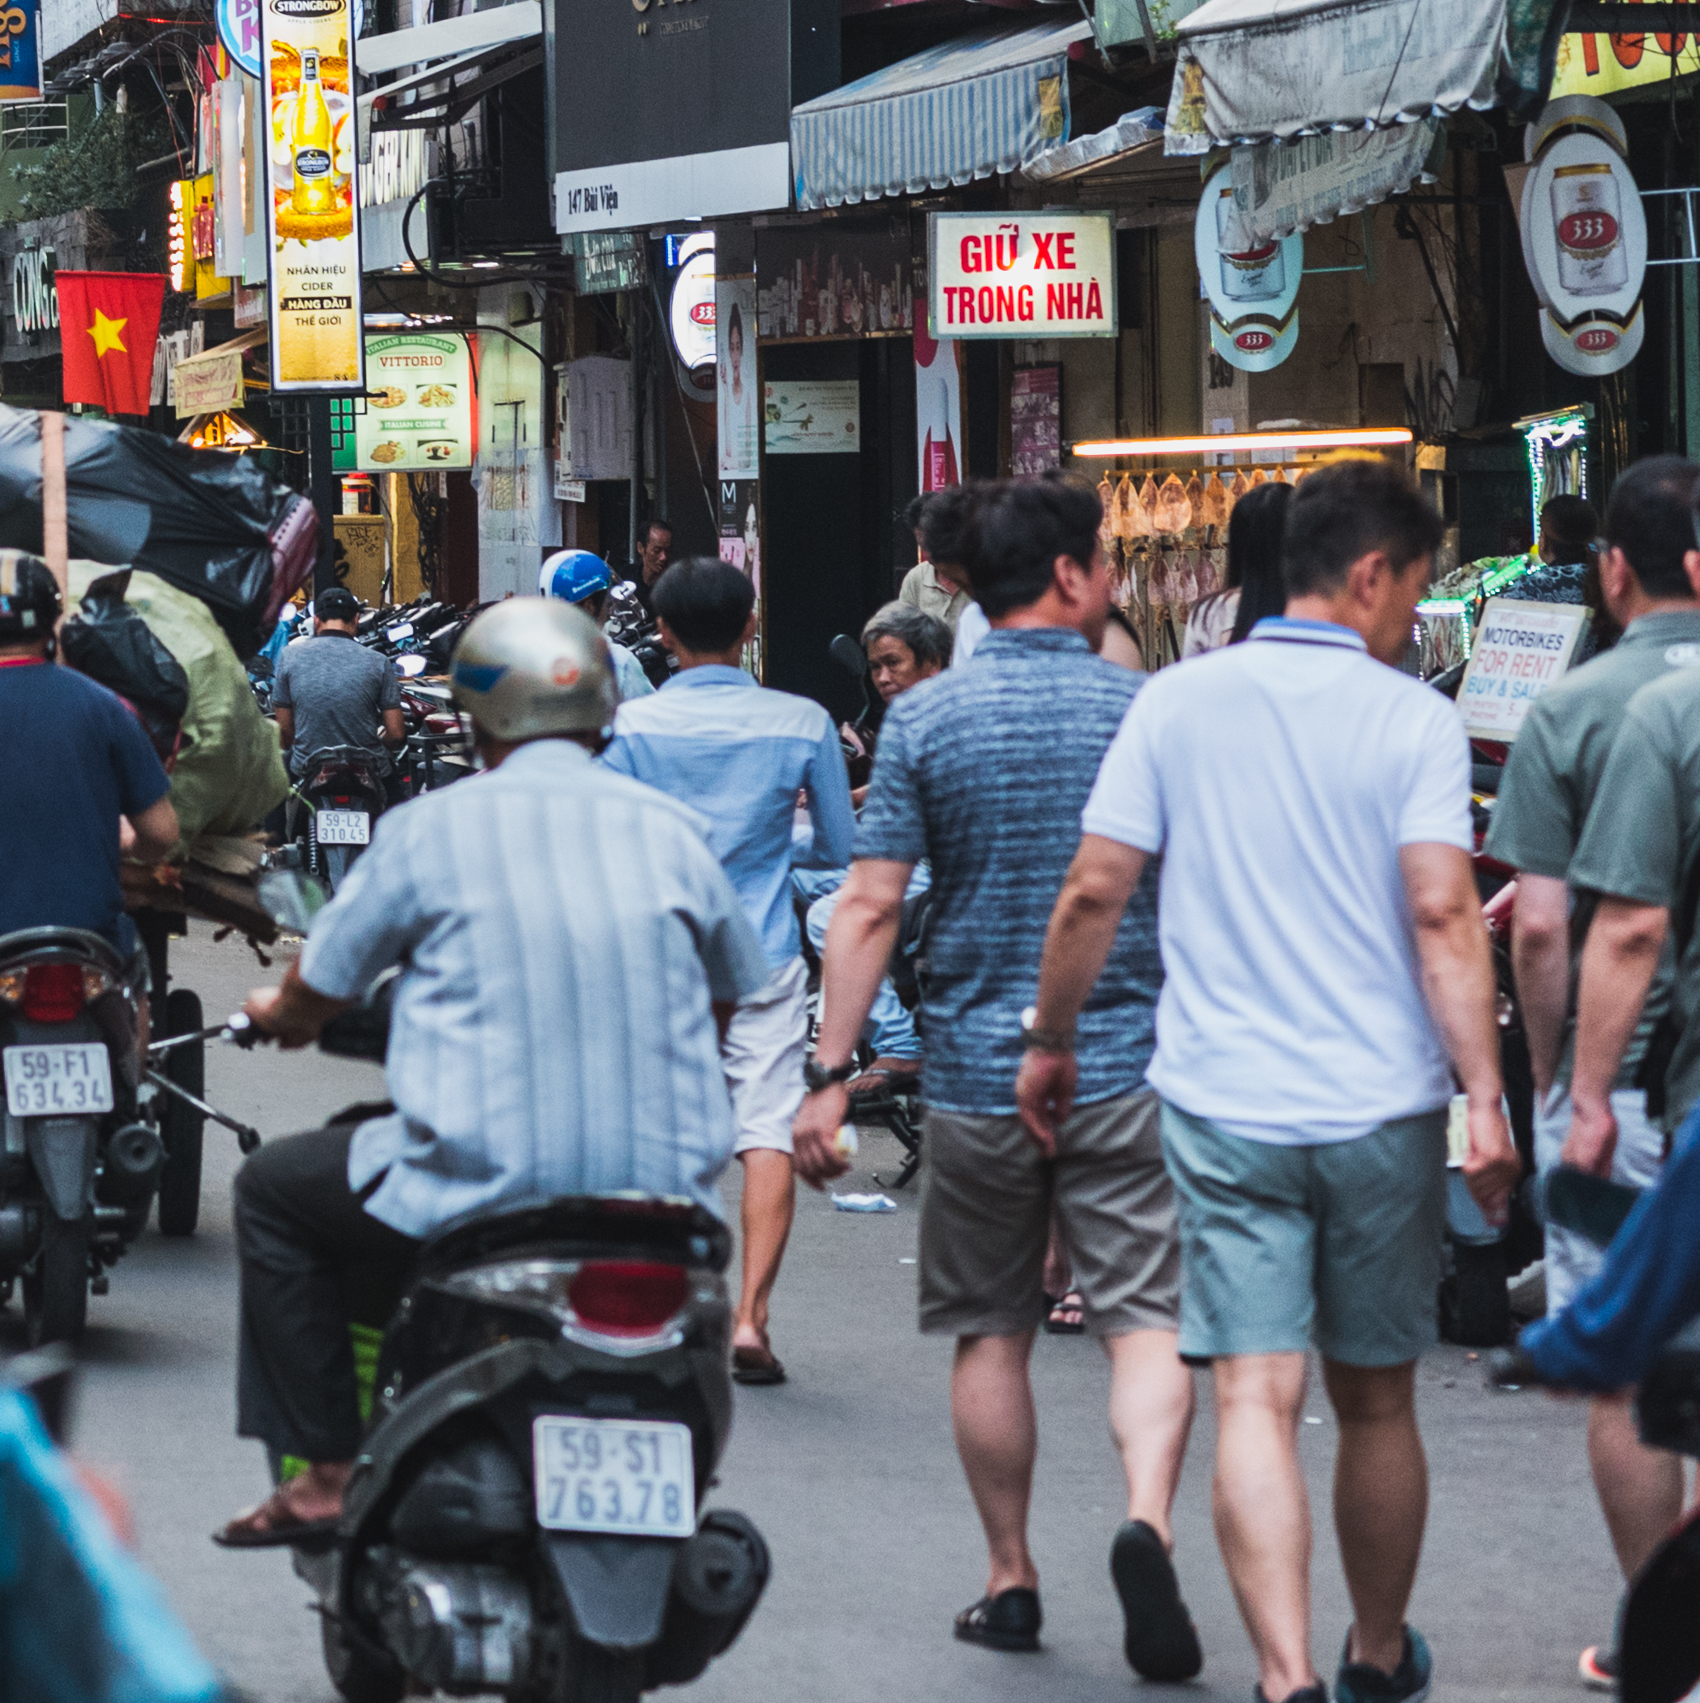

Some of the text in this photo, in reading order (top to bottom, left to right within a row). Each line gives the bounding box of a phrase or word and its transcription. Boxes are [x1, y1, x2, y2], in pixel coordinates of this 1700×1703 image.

[277, 0, 340, 13] STRONGBOW
[568, 184, 618, 215] 147 Bùi Viện
[1571, 219, 1604, 240] 333
[959, 223, 1077, 274] GIỮ XE
[321, 263, 346, 277] HIỆU
[301, 282, 333, 291] CIDER
[288, 296, 347, 310] HÀNG ĐẦU
[943, 273, 1104, 326] TRONG NHÀ
[295, 315, 342, 326] THẾ GIỚI
[367, 335, 456, 354] ITALIAN RESTAURANT
[1246, 334, 1263, 346] 333
[1586, 334, 1607, 346] 333
[379, 355, 443, 367] VITTORIO
[384, 419, 442, 429] ITALIAN CUSINE
[1482, 626, 1565, 651] MOTORBIKES
[1473, 648, 1558, 679] FOR RENT
[1466, 675, 1508, 697] BUY &
[325, 813, 362, 828] 59-L2
[321, 828, 367, 842] 310.45
[21, 1050, 90, 1079] 59-F1
[16, 1080, 104, 1111] 634.34
[560, 1425, 663, 1476] 59-S1
[546, 1476, 682, 1524] 763.78
